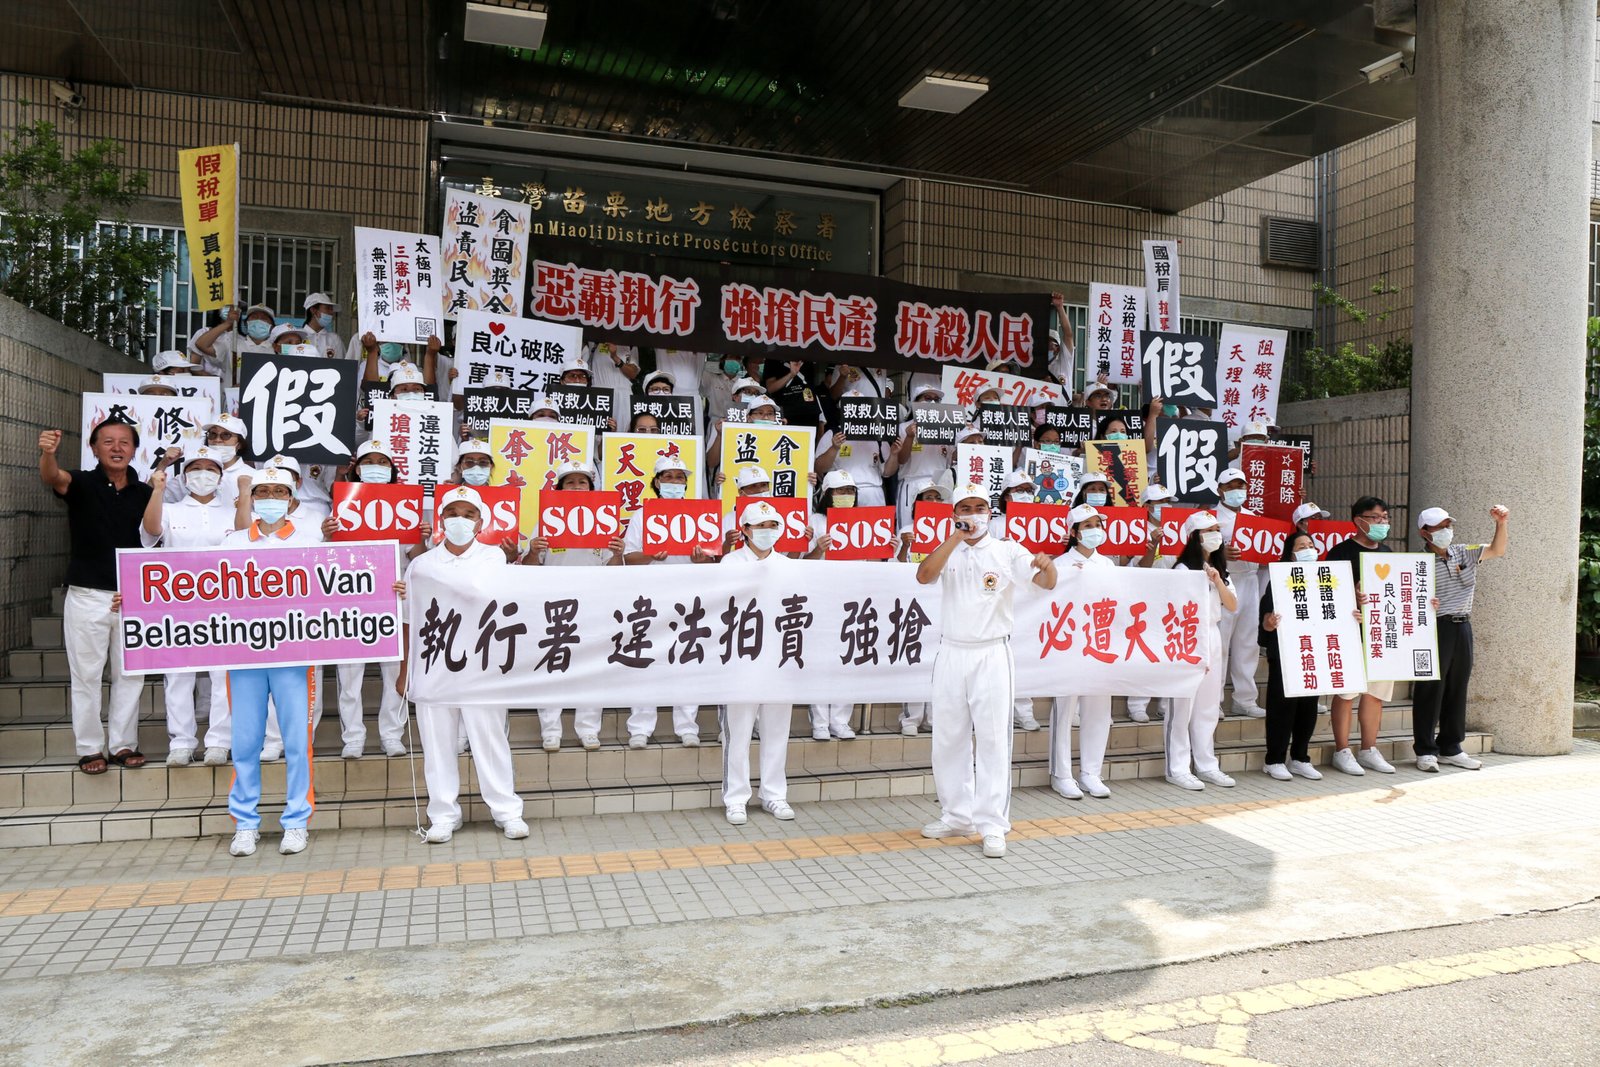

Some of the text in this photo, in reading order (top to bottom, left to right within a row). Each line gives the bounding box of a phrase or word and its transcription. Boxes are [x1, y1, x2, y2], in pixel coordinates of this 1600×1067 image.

[195, 153, 224, 303] 假稅單 真搶劫
[549, 220, 603, 240] Miaoli
[607, 225, 680, 248] District
[684, 233, 785, 257] Prosecutors
[789, 244, 833, 263] Office
[394, 245, 412, 312] 三審判決
[415, 238, 432, 288] 太極門
[483, 208, 519, 314] 貪圖獎金
[1152, 245, 1171, 293] 國稅局
[371, 247, 391, 334] 無罪無稅!
[534, 262, 1033, 365] 惡霸執行 強搶民產 坑殺人民
[1096, 292, 1113, 377] 良心救台灣
[471, 331, 566, 365] 良心破除
[1120, 294, 1137, 379] 法稅真改革
[1143, 336, 1216, 402] 假
[1222, 344, 1247, 429] 天理難容
[1248, 339, 1276, 423] 阻礙修行
[241, 360, 352, 457] 假
[466, 416, 490, 431] Pleas
[467, 395, 531, 415] 救救人民
[596, 417, 609, 430] Us!
[633, 402, 693, 419] 救救人民
[843, 403, 898, 421] 救救人民
[915, 408, 965, 425] 救救人民
[982, 410, 1030, 427] 救救人民
[1046, 412, 1091, 429] 救救人民
[390, 413, 412, 485] 搶奪民
[680, 422, 693, 435] Us!
[734, 432, 760, 464] 盜
[843, 422, 897, 439] Please Help Us!
[917, 427, 939, 440] Please
[939, 427, 955, 442] Help
[1004, 429, 1019, 444] Help
[1019, 430, 1030, 442] Us!
[1064, 429, 1079, 446] Help
[418, 414, 441, 498] 違法貪官
[771, 434, 800, 498] 貪圖
[1158, 423, 1221, 498] 假
[1279, 468, 1296, 505] 廢除
[335, 498, 420, 532] SOS
[541, 504, 620, 537] SOS
[645, 512, 720, 545] SOS
[828, 517, 893, 552] SOS
[915, 516, 955, 544] SO
[1008, 516, 1068, 545] SOS
[1234, 526, 1289, 556] SOS
[141, 560, 373, 603] Rechten Van
[1415, 560, 1428, 627] 違法官員
[1384, 582, 1398, 649] 良心覺醒
[1400, 571, 1414, 637] 回頭是岸
[123, 609, 395, 650] Belastingplichtige
[418, 593, 1202, 675] 執行署 違法拍賣 強搶 必遭天譴
[1290, 566, 1319, 691] 假稅單 真搶劫
[1317, 566, 1345, 689] 假證據 真陷害
[1368, 593, 1383, 659] 平反假案
